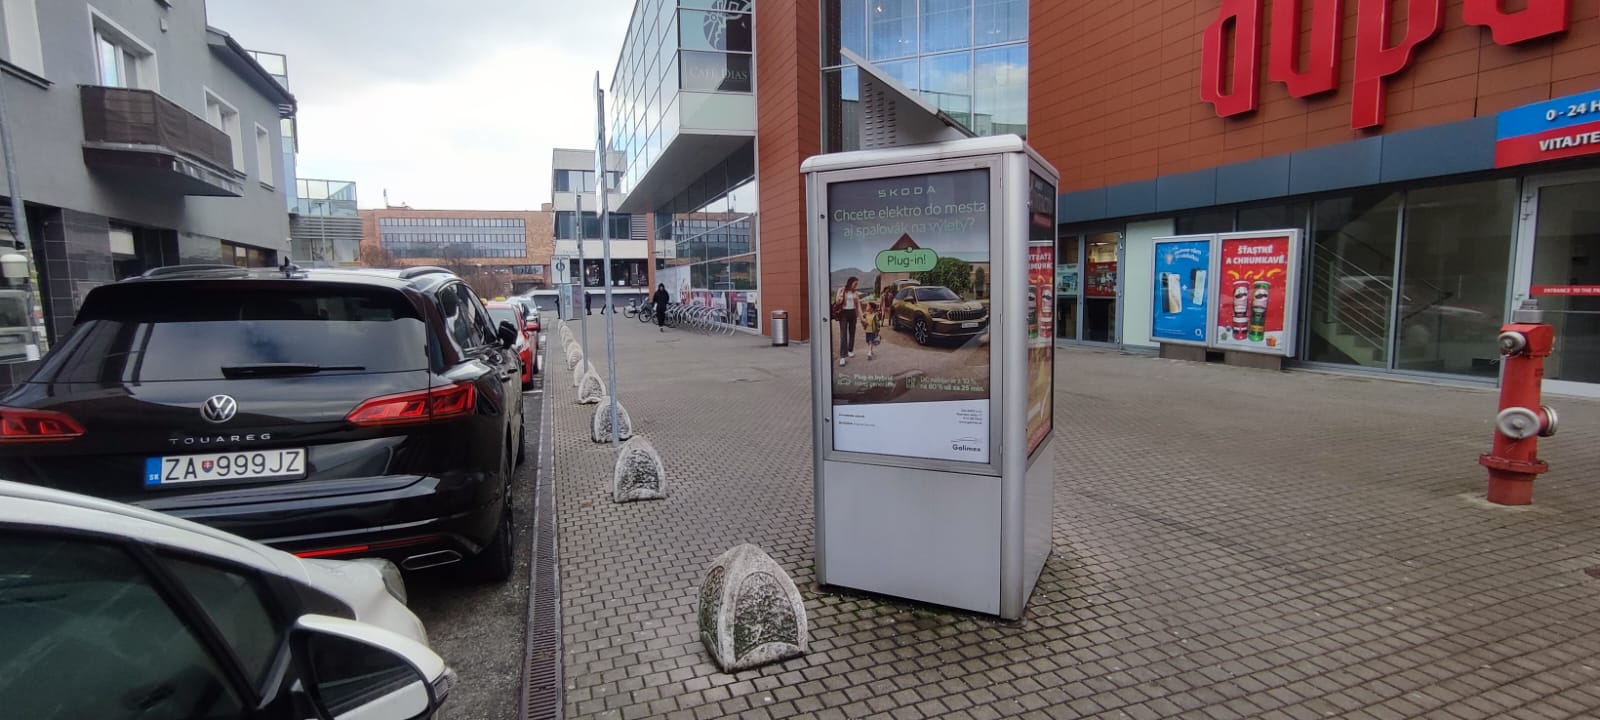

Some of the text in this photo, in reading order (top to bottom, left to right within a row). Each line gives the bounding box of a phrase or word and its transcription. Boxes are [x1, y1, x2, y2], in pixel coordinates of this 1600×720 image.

[1545, 109, 1557, 121] 0
[1567, 102, 1588, 117] 24
[1539, 131, 1600, 151] VITAJTE
[833, 200, 987, 223] Chcete elektro do mesta
[843, 226, 854, 240] aj
[911, 223, 926, 234] na
[887, 255, 927, 267] Plug-in!
[169, 432, 272, 446] TOUAREG
[165, 457, 198, 481] ZA
